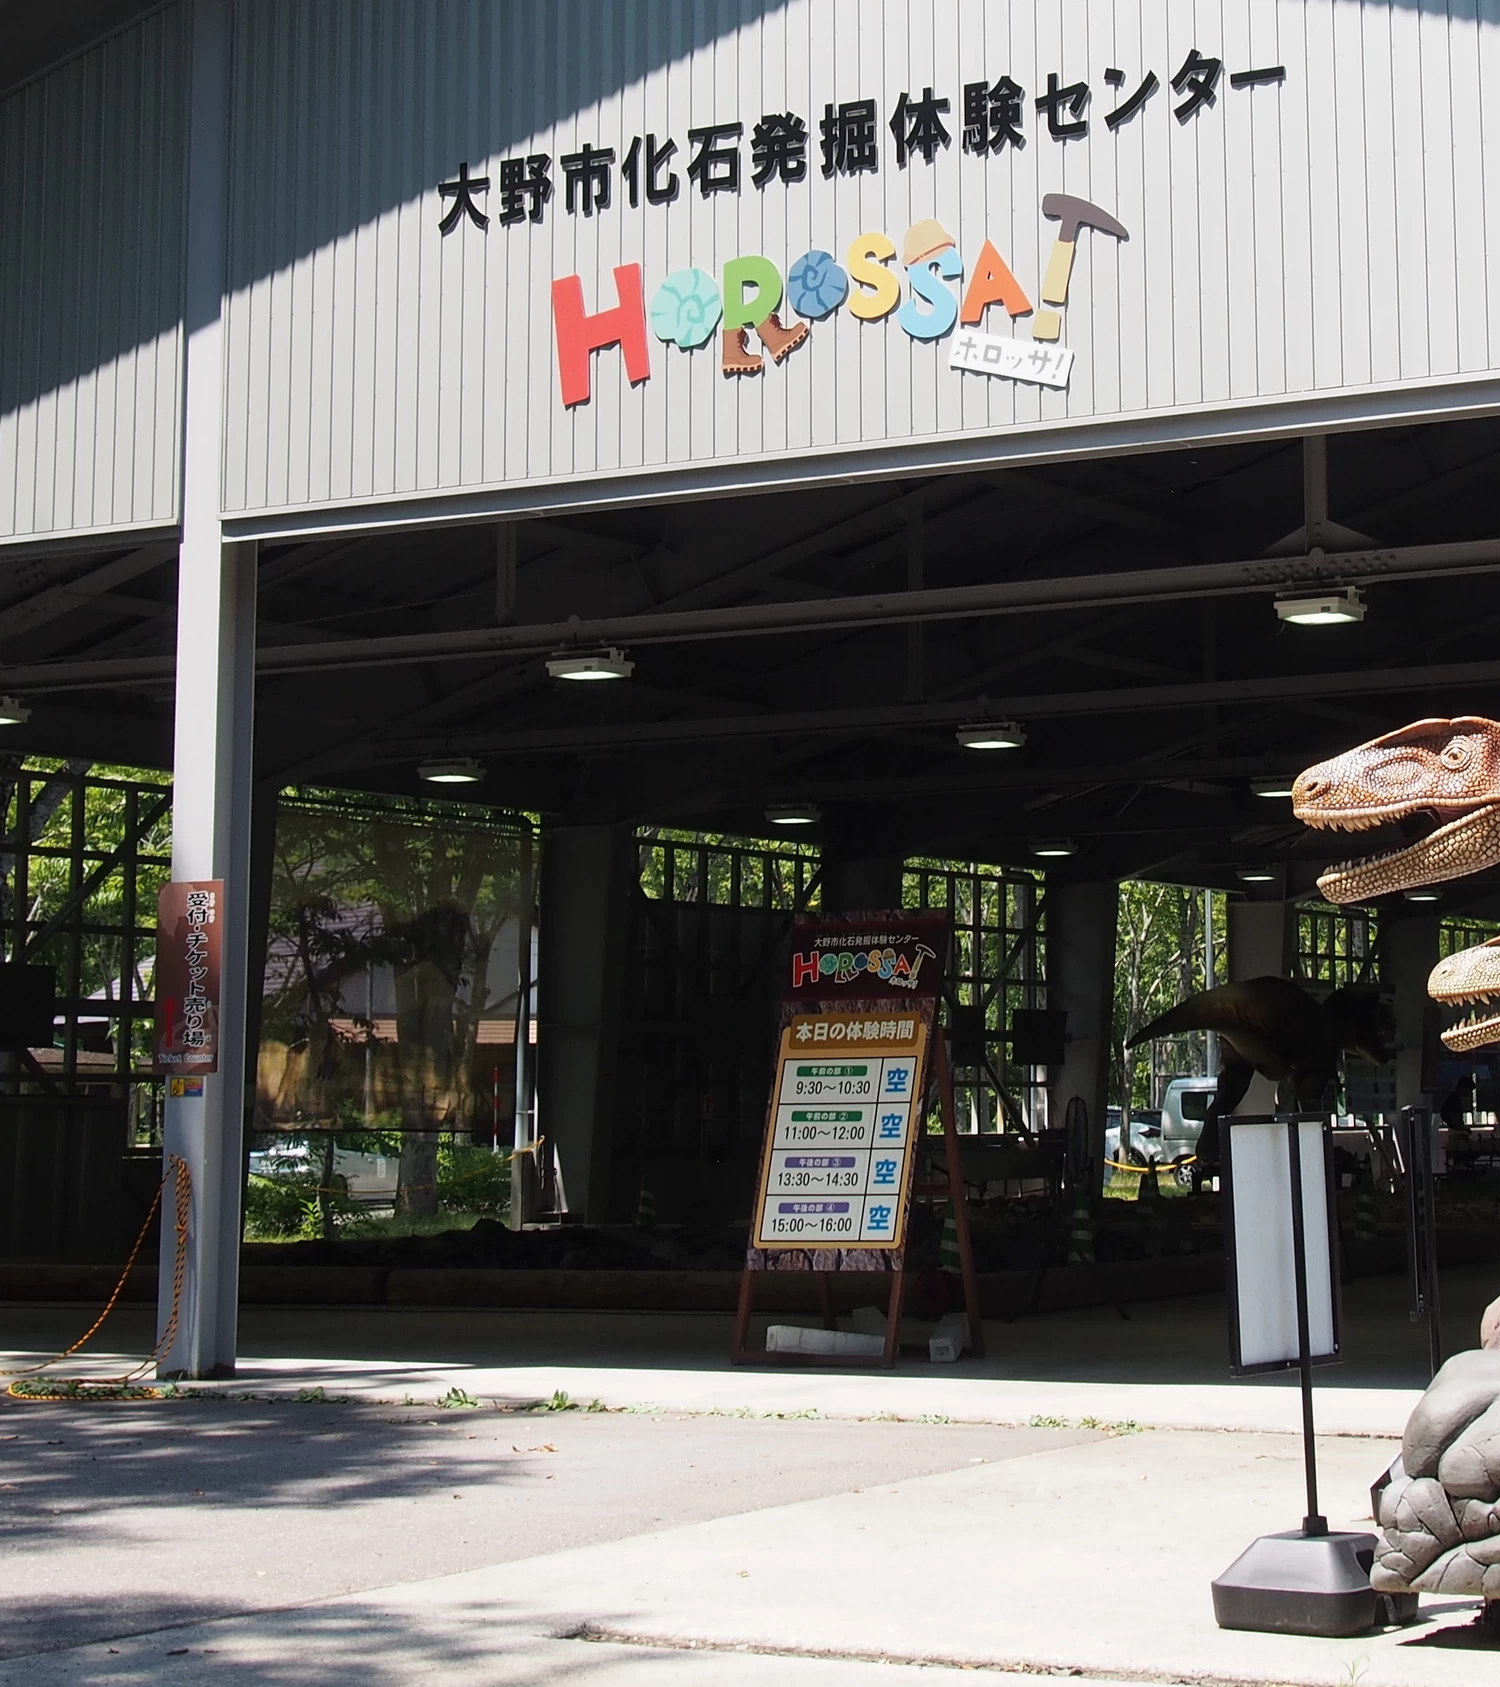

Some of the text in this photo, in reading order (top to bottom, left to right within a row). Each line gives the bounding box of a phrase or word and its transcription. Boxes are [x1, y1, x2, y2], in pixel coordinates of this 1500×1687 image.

[437, 49, 1285, 236] 大野市化石発掘体験センター
[952, 335, 1063, 382] ホロッサ!
[814, 934, 920, 948] 大野市化石発掘体験センター
[183, 891, 208, 1046] 受付・チケット売り場
[796, 1020, 914, 1042] 本日の体験時間
[158, 1053, 213, 1064] Ticket Counter
[811, 1067, 841, 1075] 午前の部
[885, 1067, 909, 1092] 空
[806, 1112, 837, 1120] 午前の部
[879, 1113, 903, 1138] 空
[799, 1158, 829, 1167] 午後の部
[873, 1159, 897, 1184] 空
[792, 1204, 823, 1213] 午後の部
[867, 1205, 891, 1230] 空
